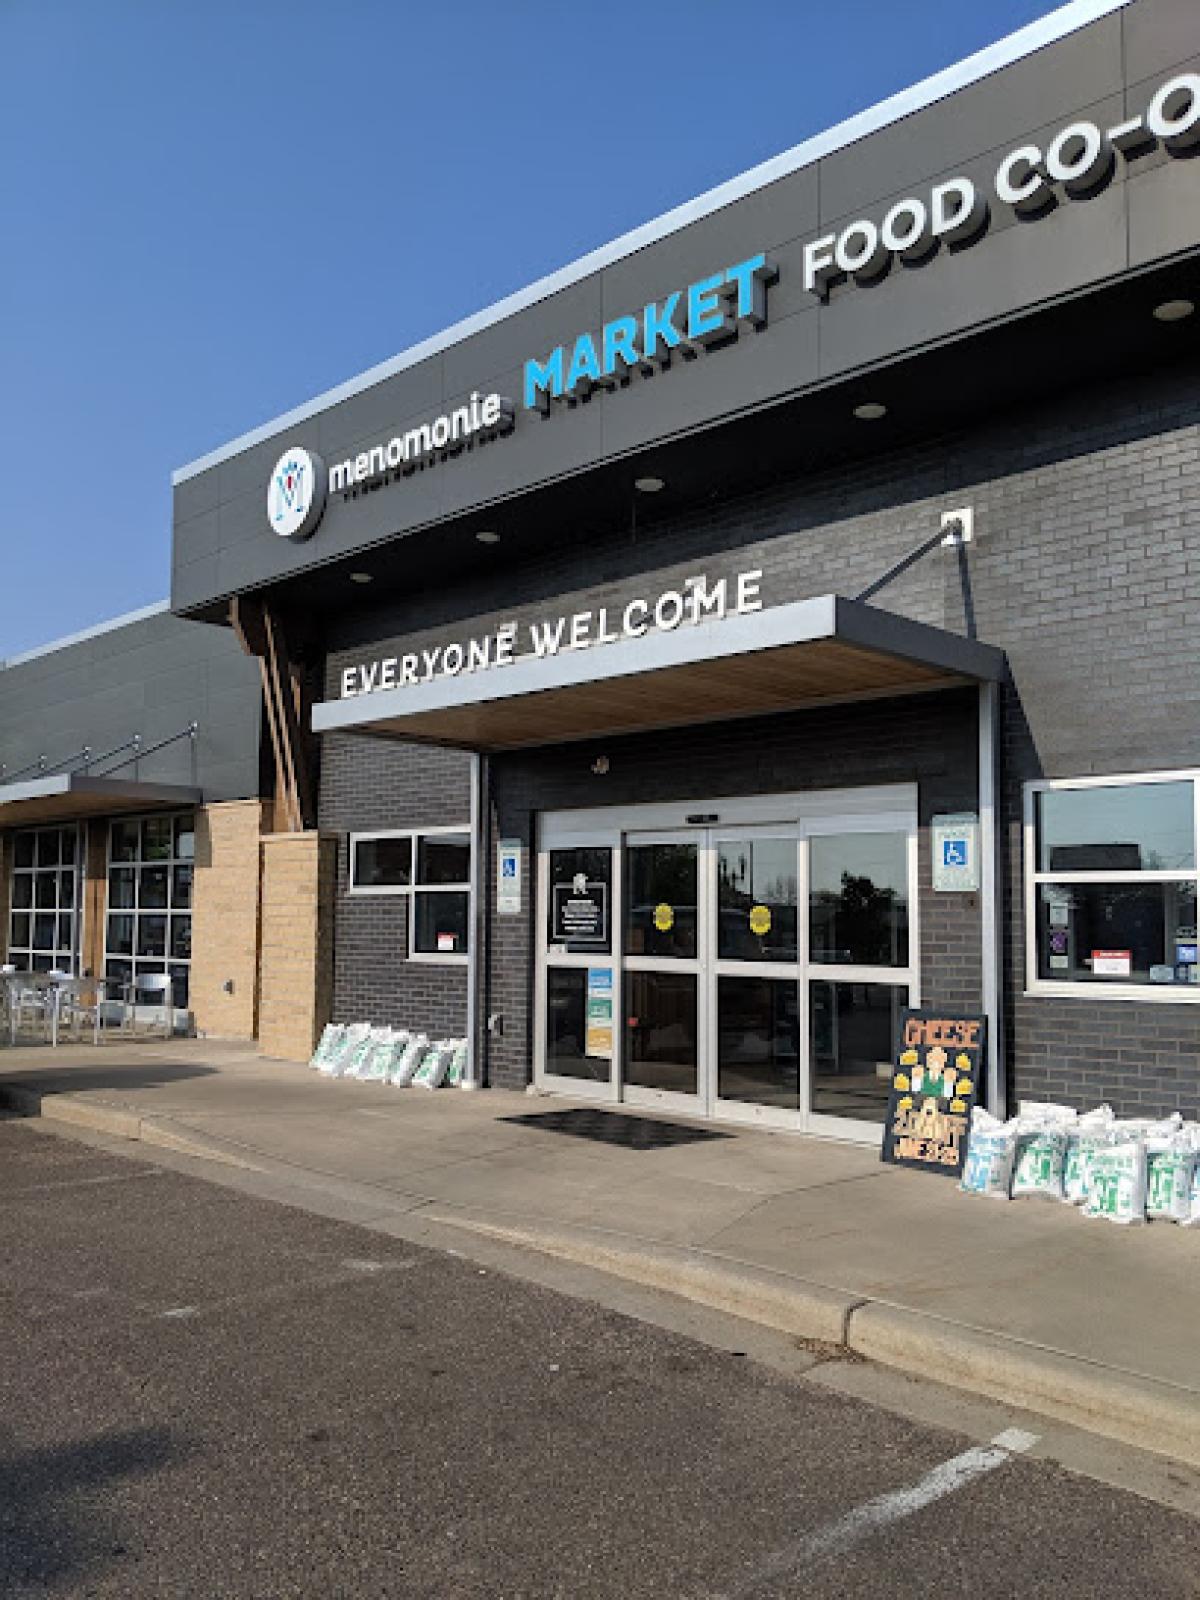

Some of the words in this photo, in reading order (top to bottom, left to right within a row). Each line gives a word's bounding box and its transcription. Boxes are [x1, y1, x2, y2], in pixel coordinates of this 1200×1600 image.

[328, 390, 501, 492] menomonie
[523, 253, 766, 409] MARKET
[803, 177, 975, 290] FOOD
[340, 625, 516, 698] EVERYONE
[529, 569, 764, 659] WELCOME
